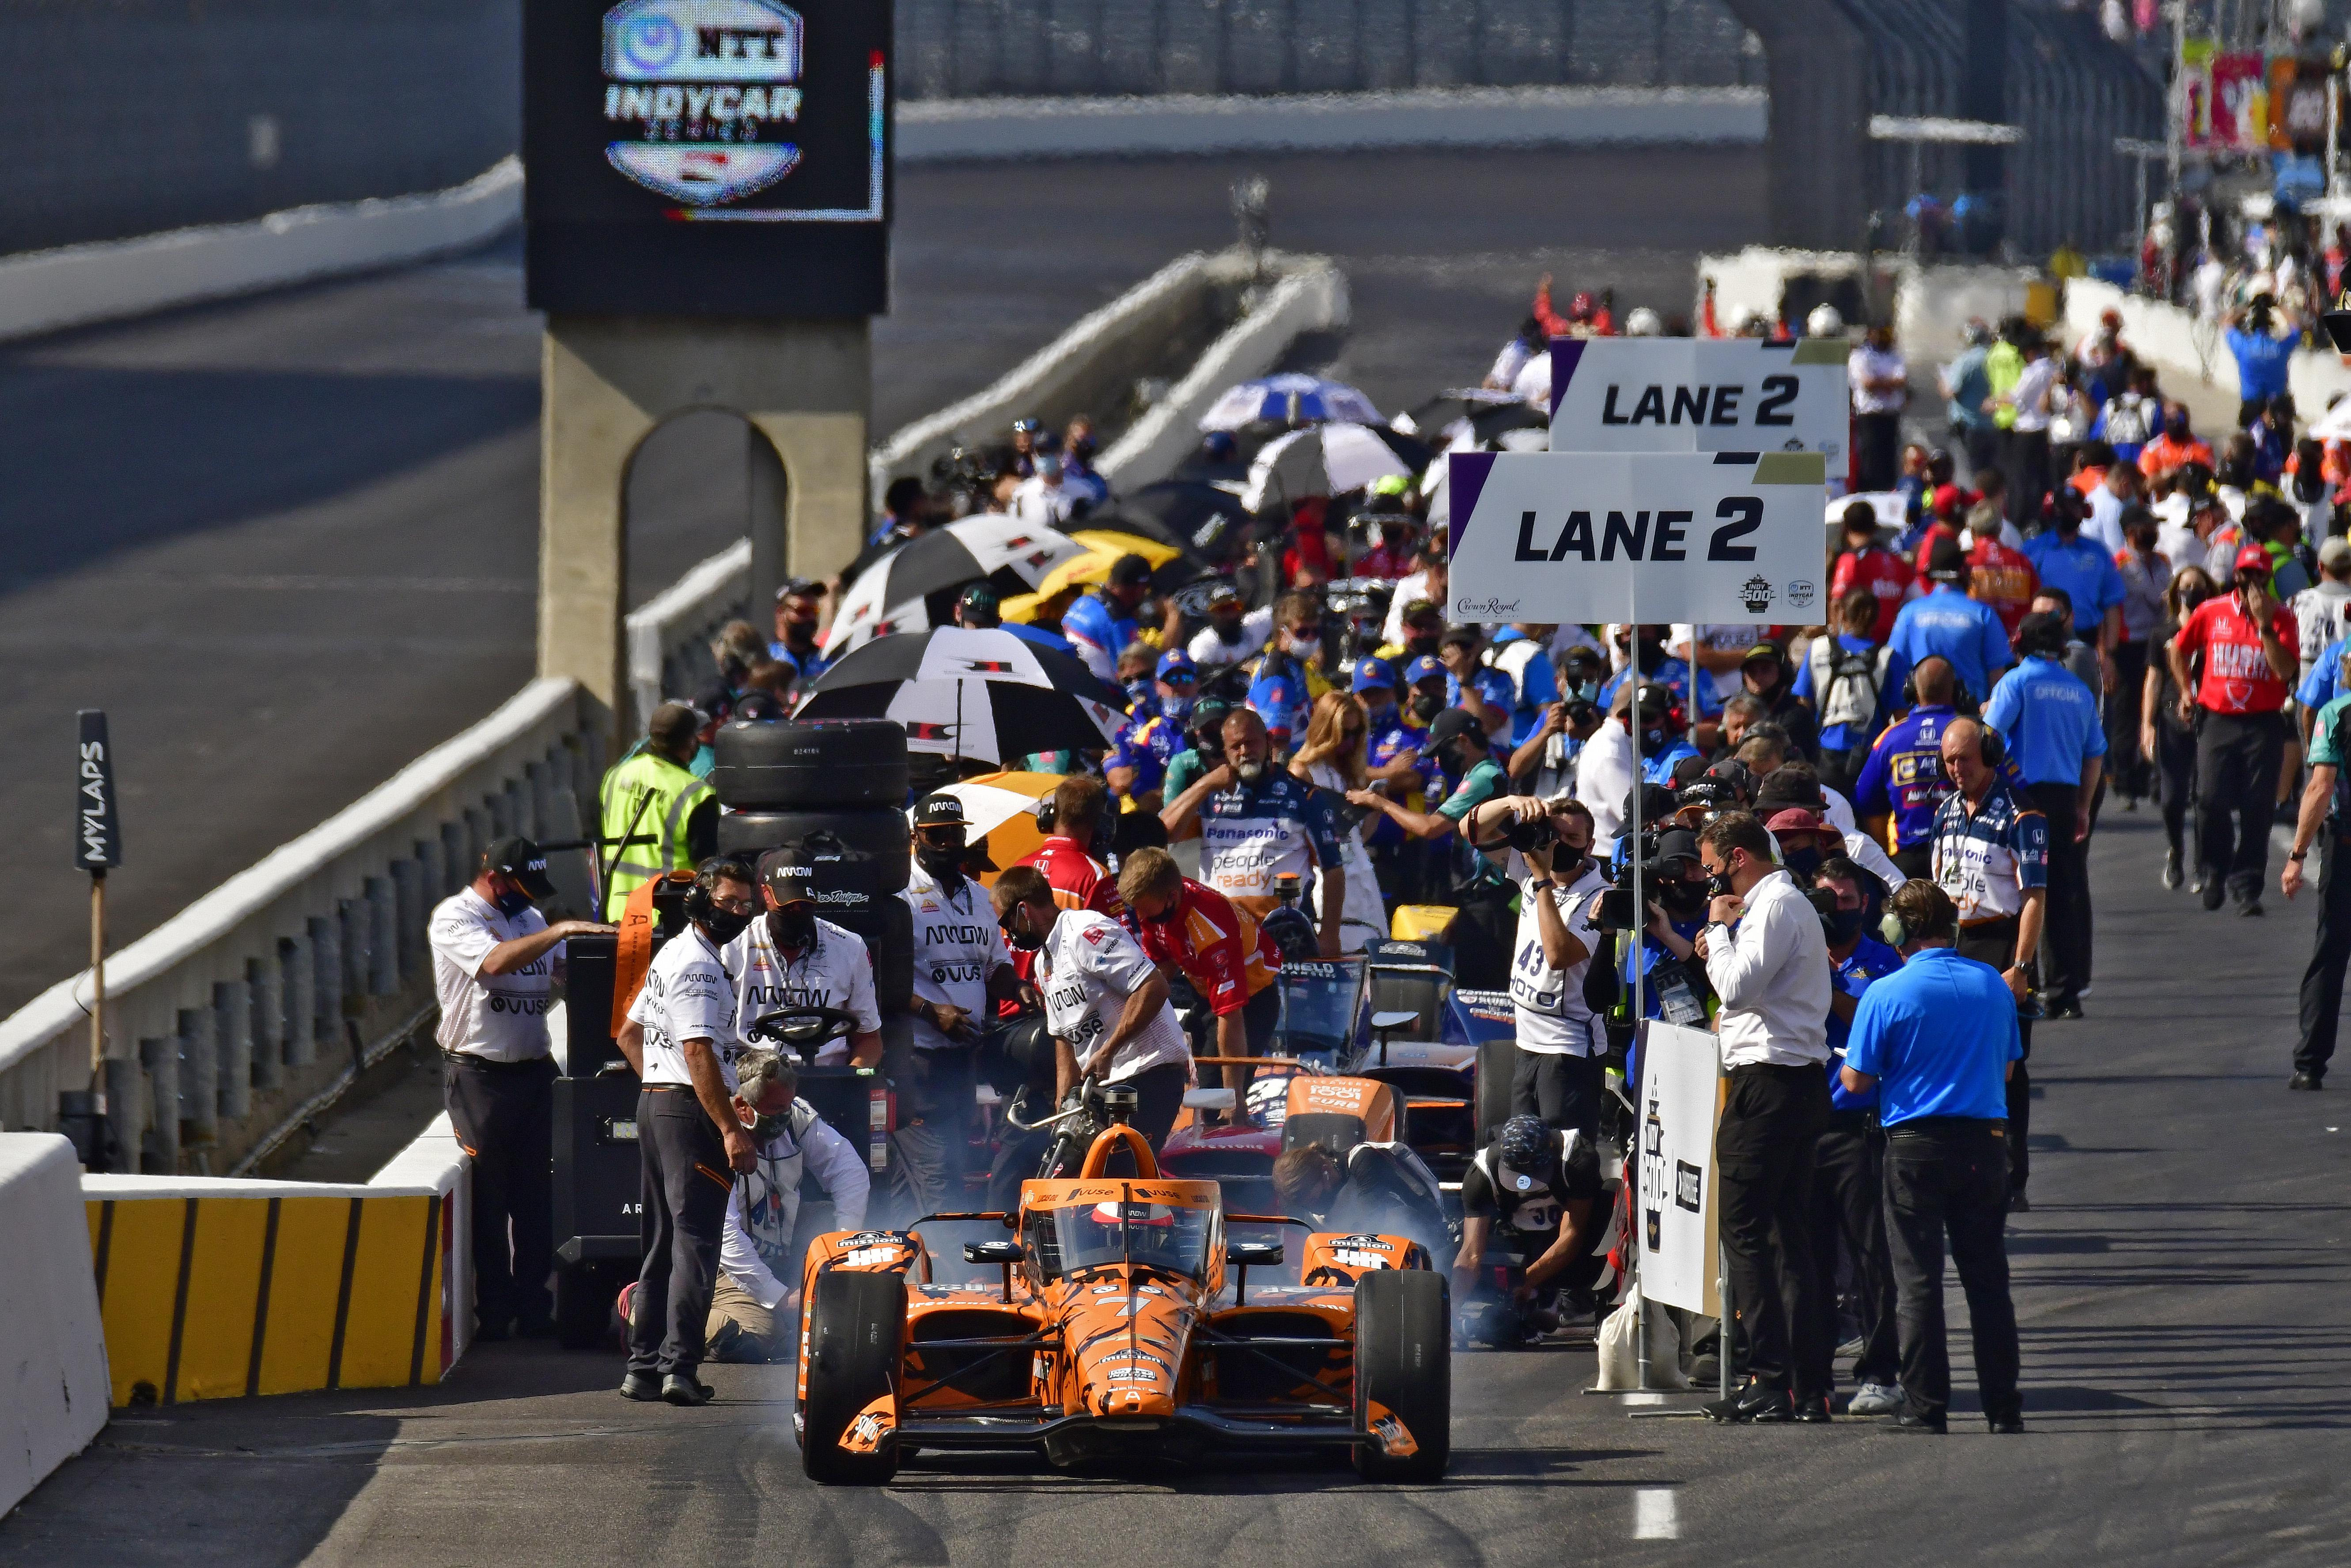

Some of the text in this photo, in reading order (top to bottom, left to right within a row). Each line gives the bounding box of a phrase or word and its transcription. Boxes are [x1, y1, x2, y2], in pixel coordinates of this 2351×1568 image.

[698, 28, 783, 58] NTT
[604, 84, 803, 122] INDYCAR
[1602, 375, 1800, 426] LANE 2
[1515, 496, 1764, 561] LANE 2
[1457, 597, 1487, 614] Crown
[1743, 590, 1771, 601] 500
[2034, 685, 2081, 703] OFFICIAL
[80, 740, 107, 862] MYLAPS
[928, 802, 962, 813] ARROW
[1207, 818, 1289, 840] Panasonic
[1214, 850, 1276, 873] people
[776, 867, 813, 878] ARROW
[1217, 869, 1272, 891] ready
[926, 925, 989, 946] ARROW
[1517, 939, 1545, 977] 43
[685, 974, 717, 984] ARROW
[747, 986, 831, 1007] ARROW
[1308, 1097, 1360, 1109] CURB
[1079, 1187, 1114, 1196] vuse
[1645, 1153, 1664, 1213] 500
[1147, 1189, 1180, 1199] vuse
[1331, 1240, 1392, 1250] mission
[1094, 1296, 1152, 1317] 7
[1102, 1354, 1161, 1363] mission
[1125, 1391, 1141, 1401] A
